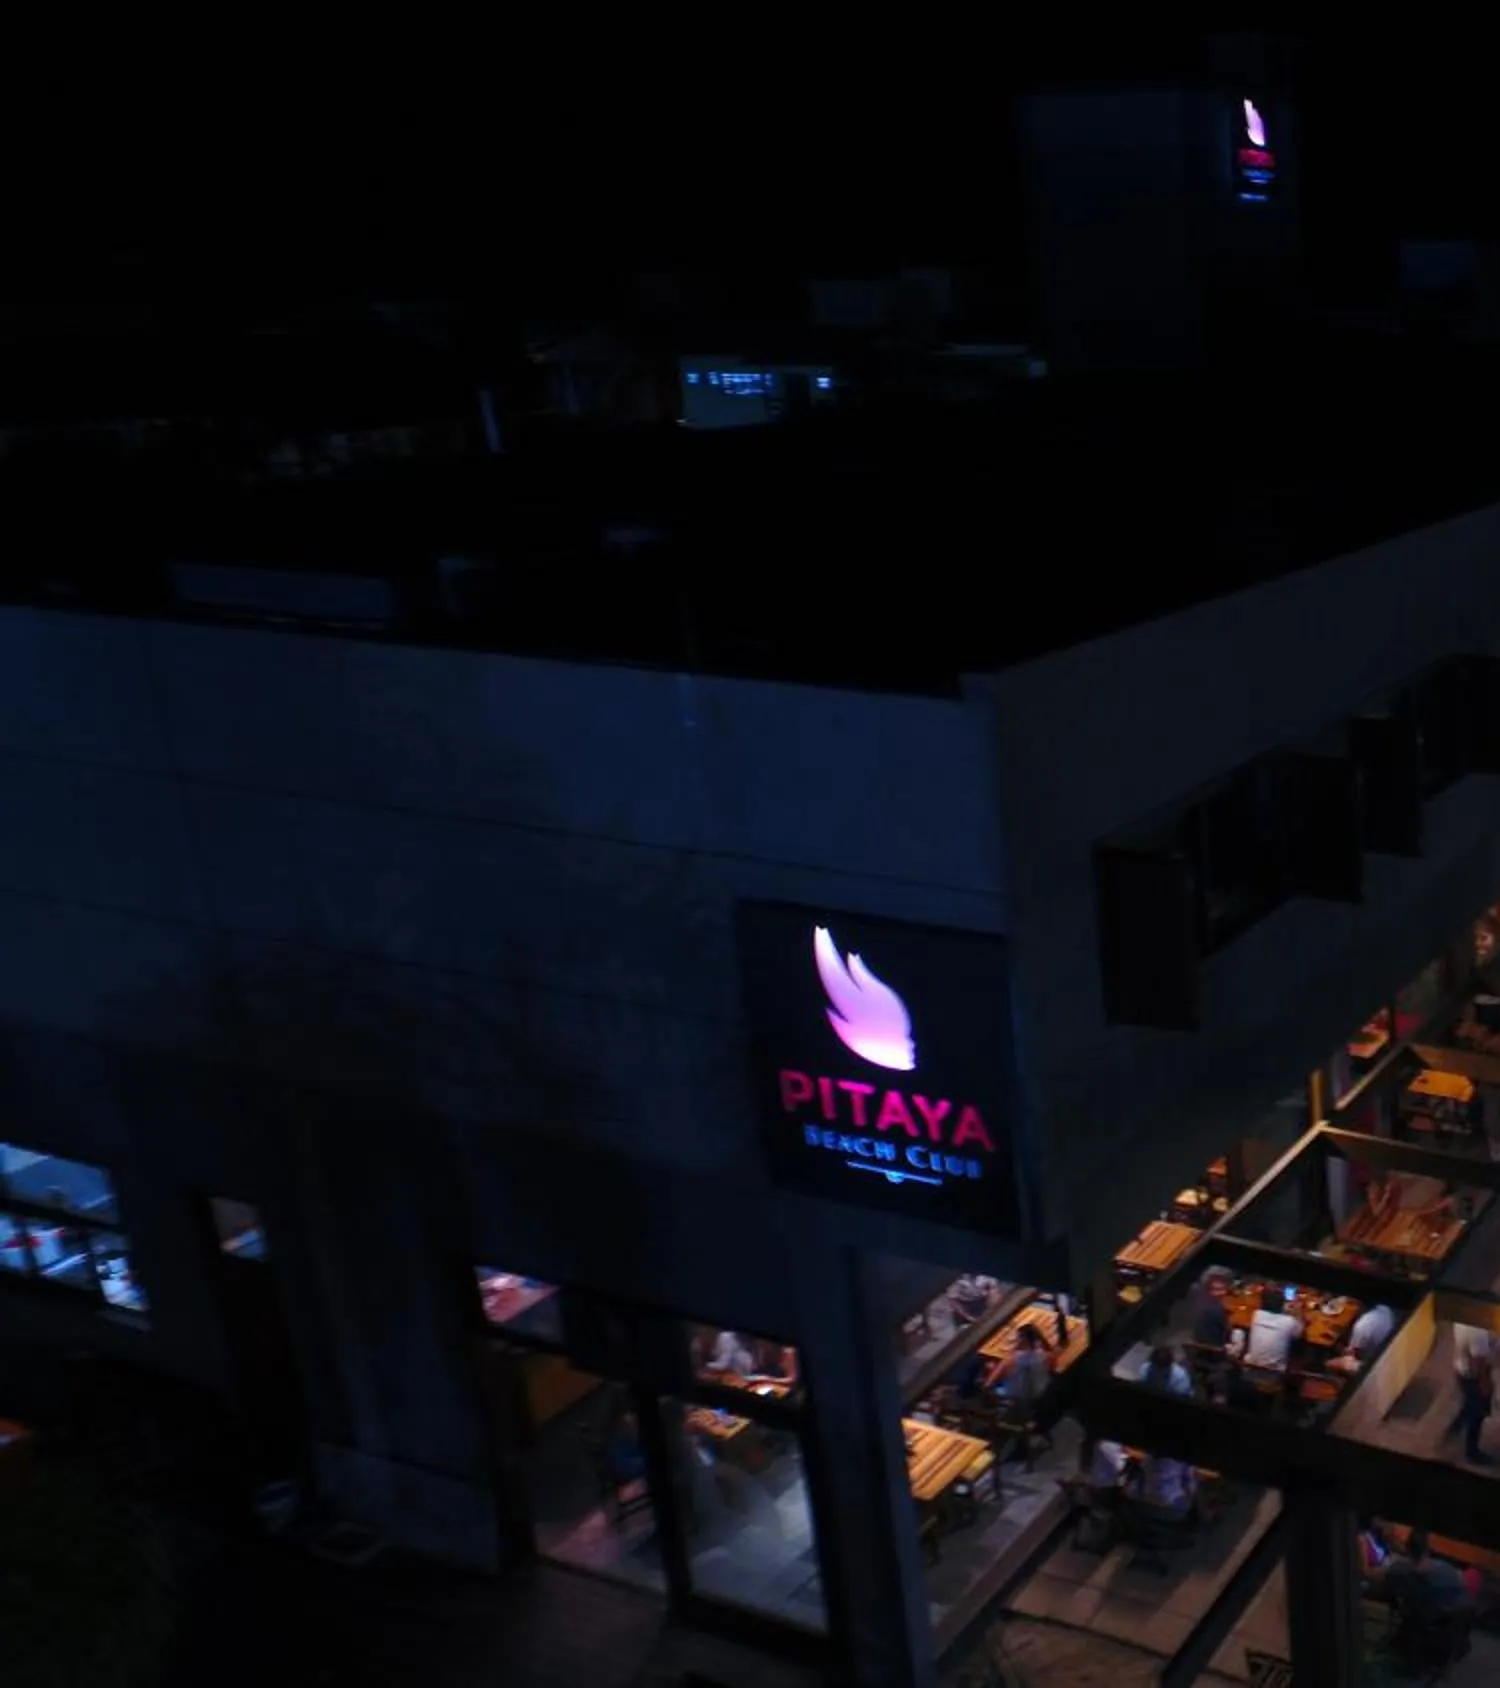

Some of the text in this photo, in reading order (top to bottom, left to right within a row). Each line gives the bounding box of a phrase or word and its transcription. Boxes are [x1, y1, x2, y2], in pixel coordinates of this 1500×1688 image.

[778, 1069, 995, 1152] PITAYA
[803, 1122, 984, 1180] BEACH CLUB
